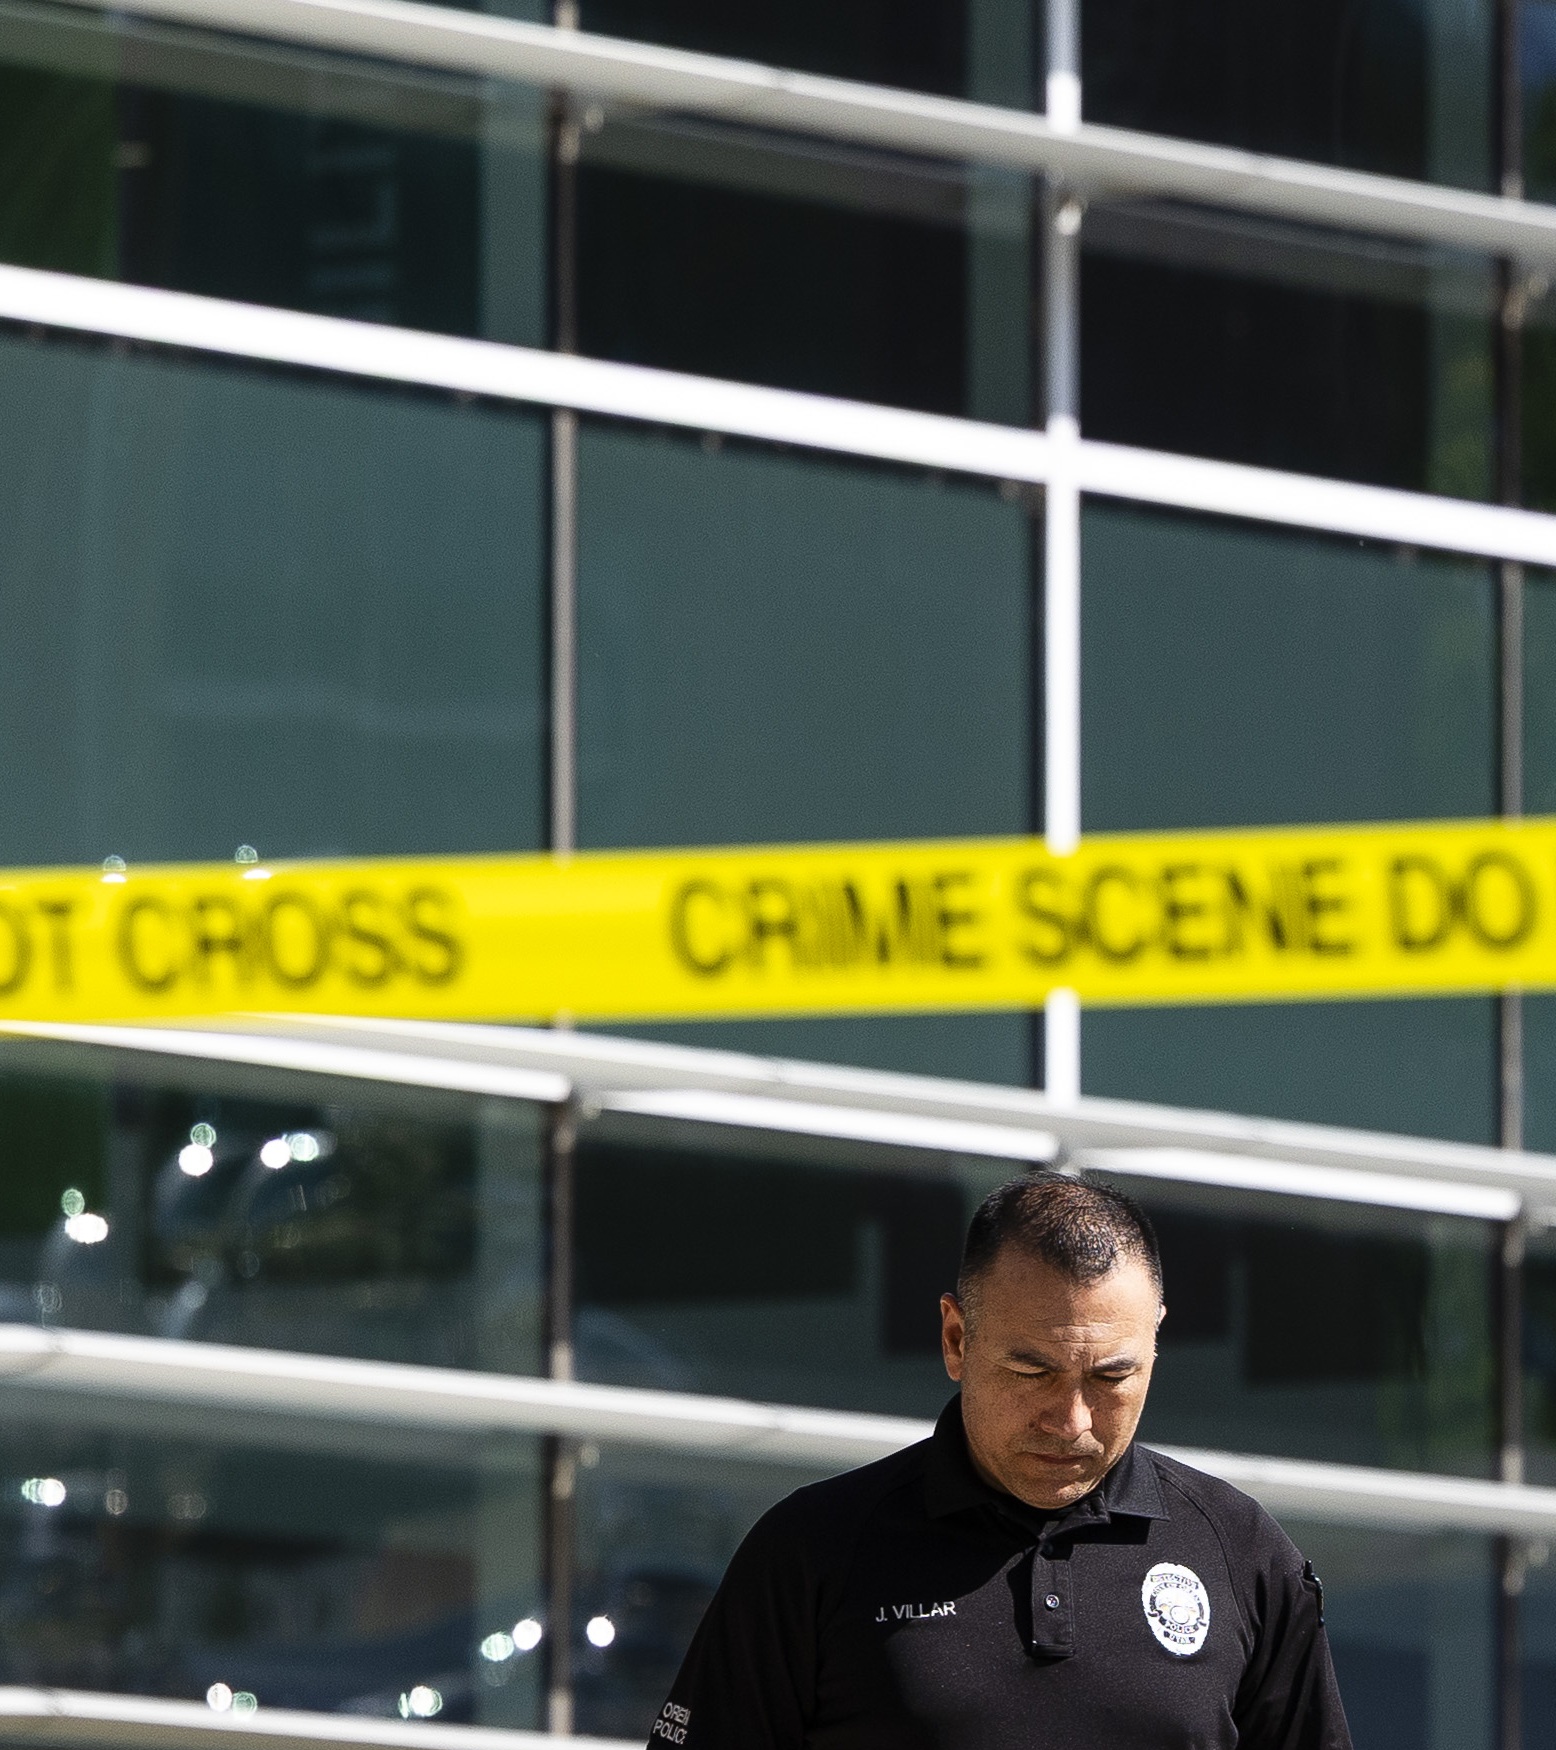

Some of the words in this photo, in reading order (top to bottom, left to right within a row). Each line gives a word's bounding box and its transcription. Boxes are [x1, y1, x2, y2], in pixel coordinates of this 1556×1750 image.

[118, 886, 465, 993] CROSS
[670, 870, 984, 977] CRIME
[1016, 856, 1353, 965] SCENE
[1391, 848, 1537, 954] DO
[875, 1606, 888, 1622] J.
[892, 1601, 957, 1619] VILLAR
